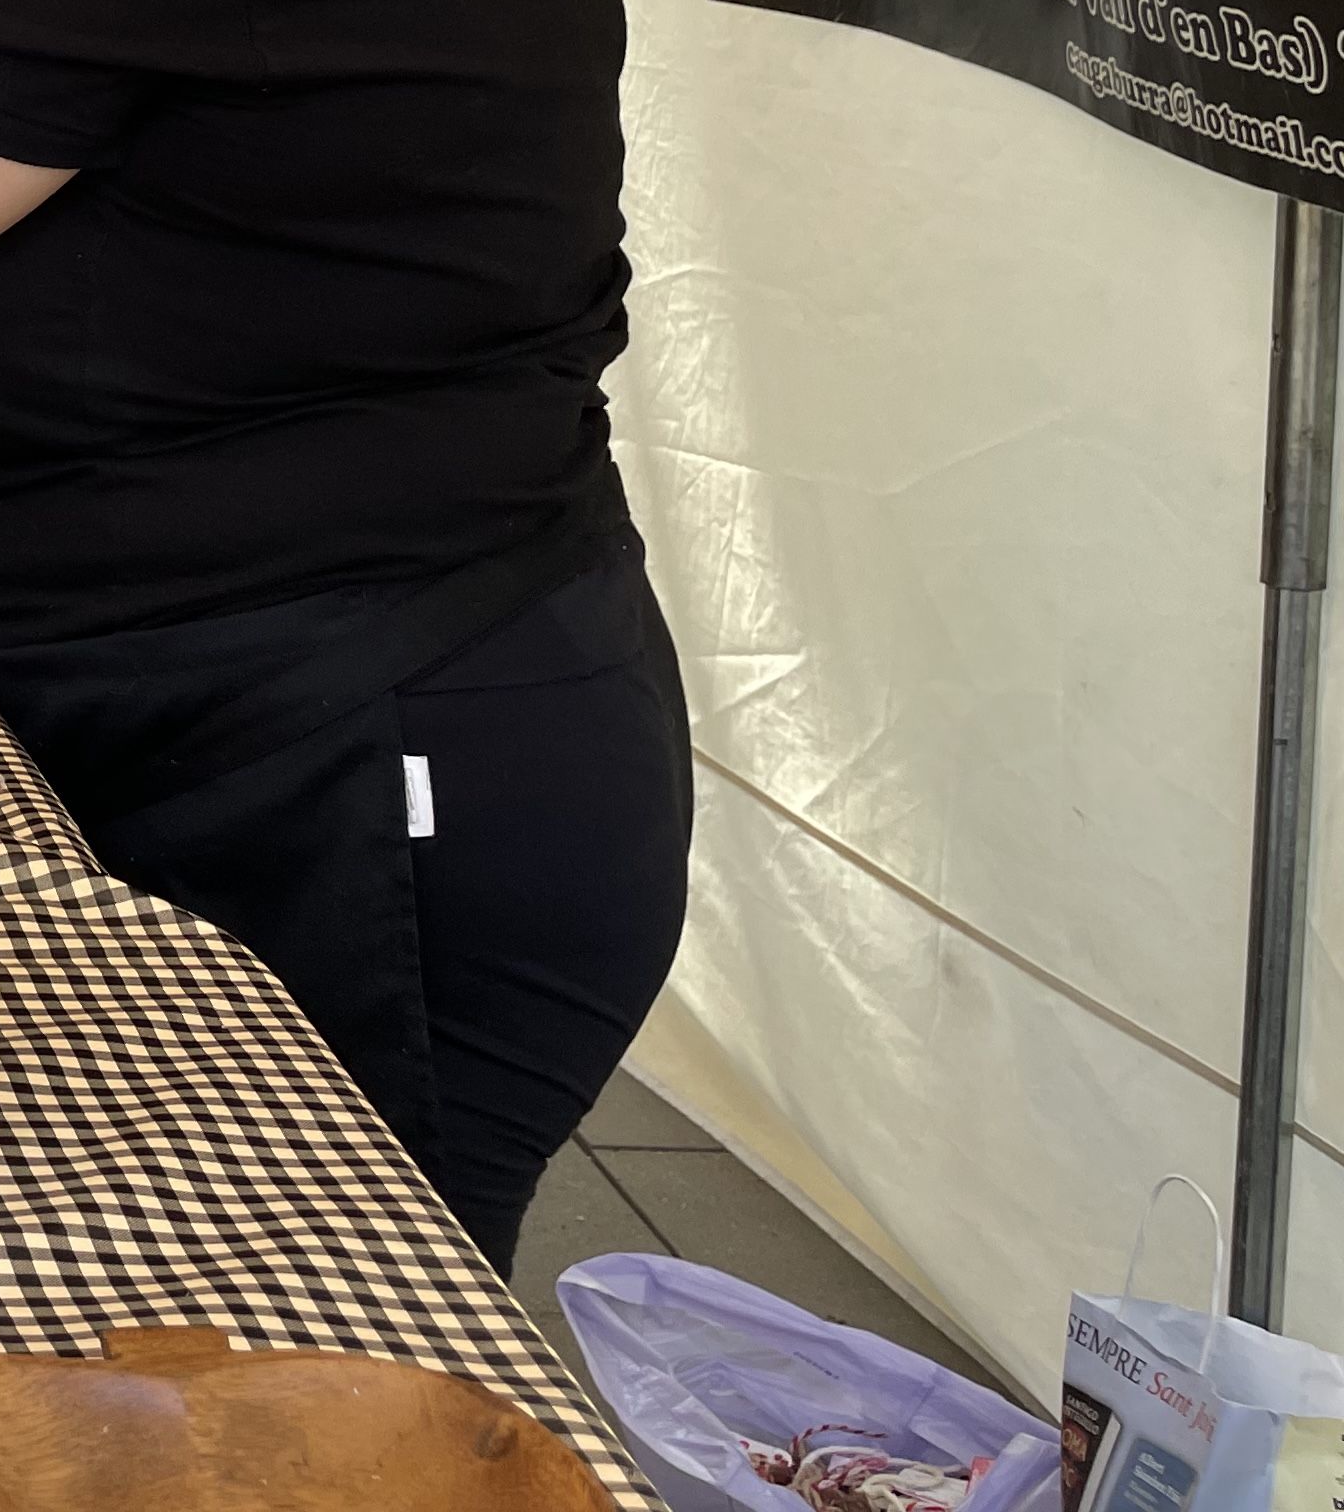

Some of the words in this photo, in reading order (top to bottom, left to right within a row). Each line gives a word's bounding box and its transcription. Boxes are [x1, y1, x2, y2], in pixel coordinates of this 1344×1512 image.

[1219, 6, 1330, 95] Bas)
[1065, 1311, 1148, 1387] SEMPRE
[1145, 1371, 1194, 1419] Sant
